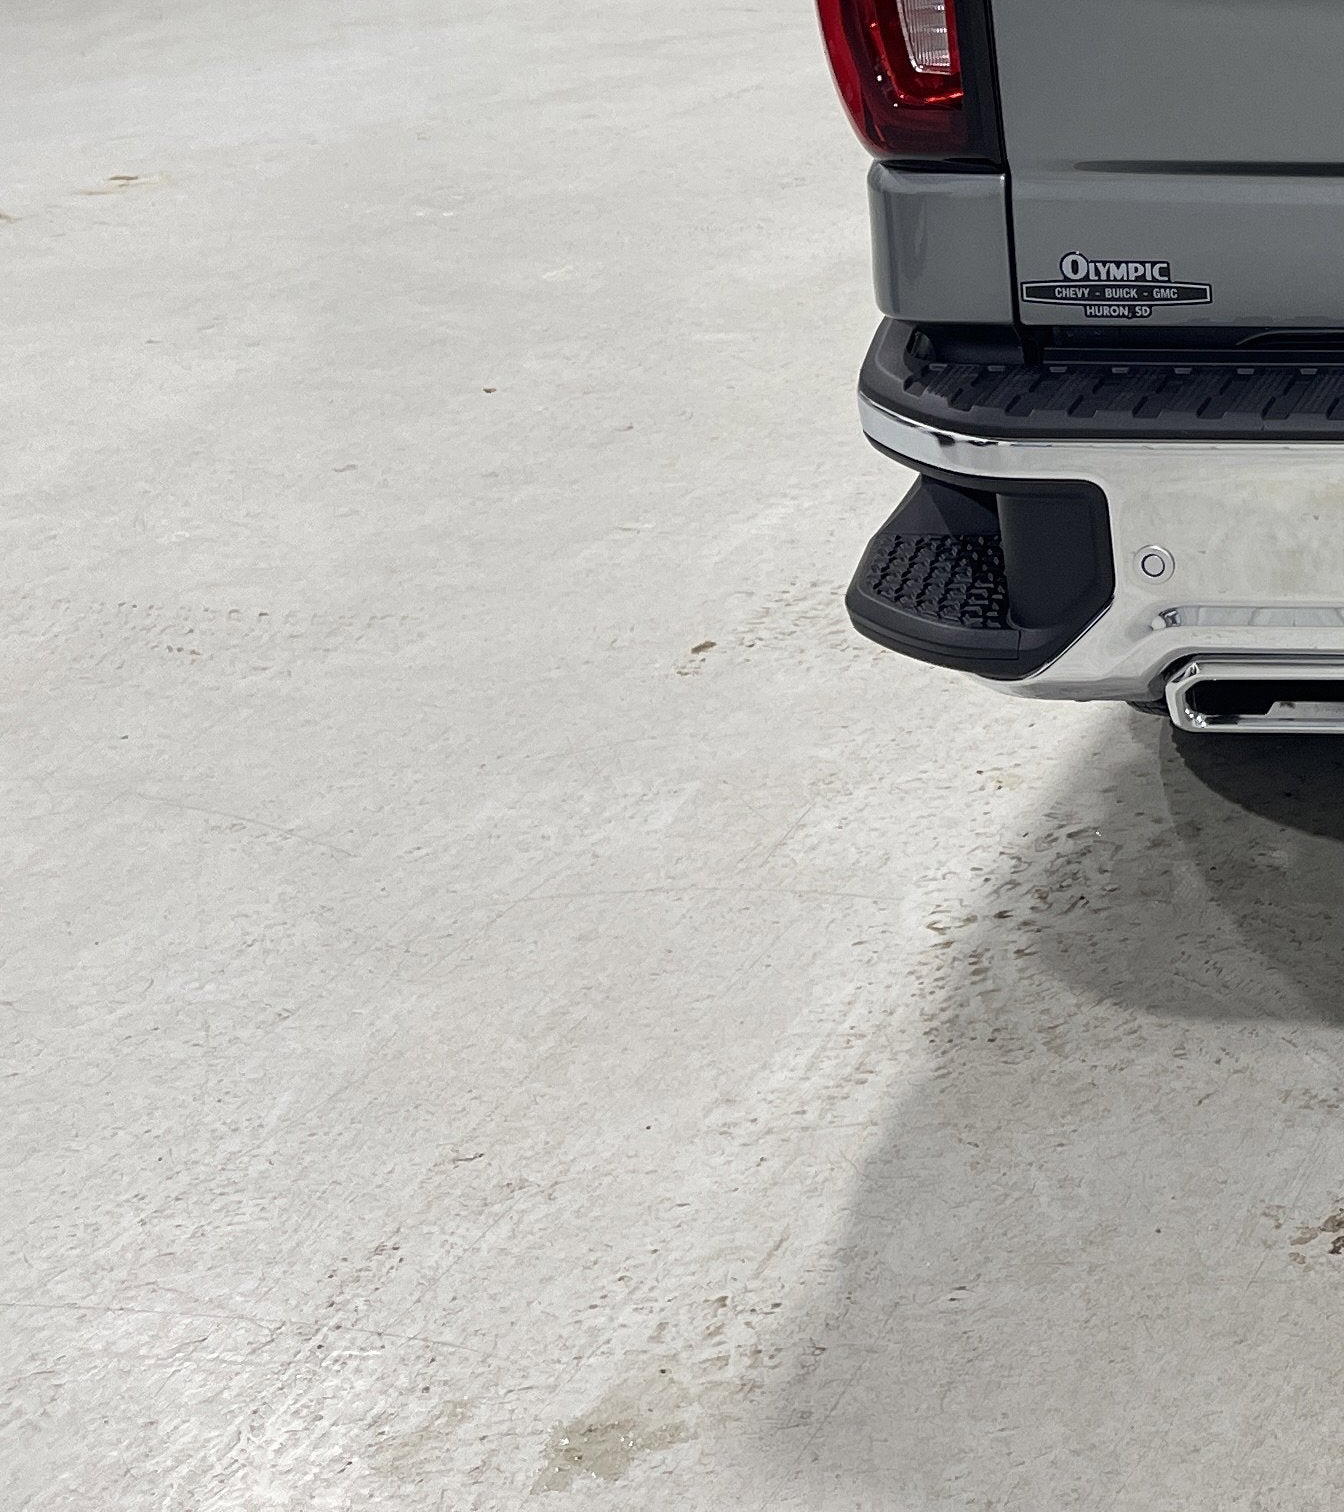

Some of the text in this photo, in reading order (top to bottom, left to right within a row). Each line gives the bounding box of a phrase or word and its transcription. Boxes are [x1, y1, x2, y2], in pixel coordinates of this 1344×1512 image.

[1054, 287, 1090, 298] CHEVY
[1105, 287, 1138, 299] BUICK
[1153, 288, 1178, 299] GMC
[1086, 306, 1150, 318] HURON, SD
